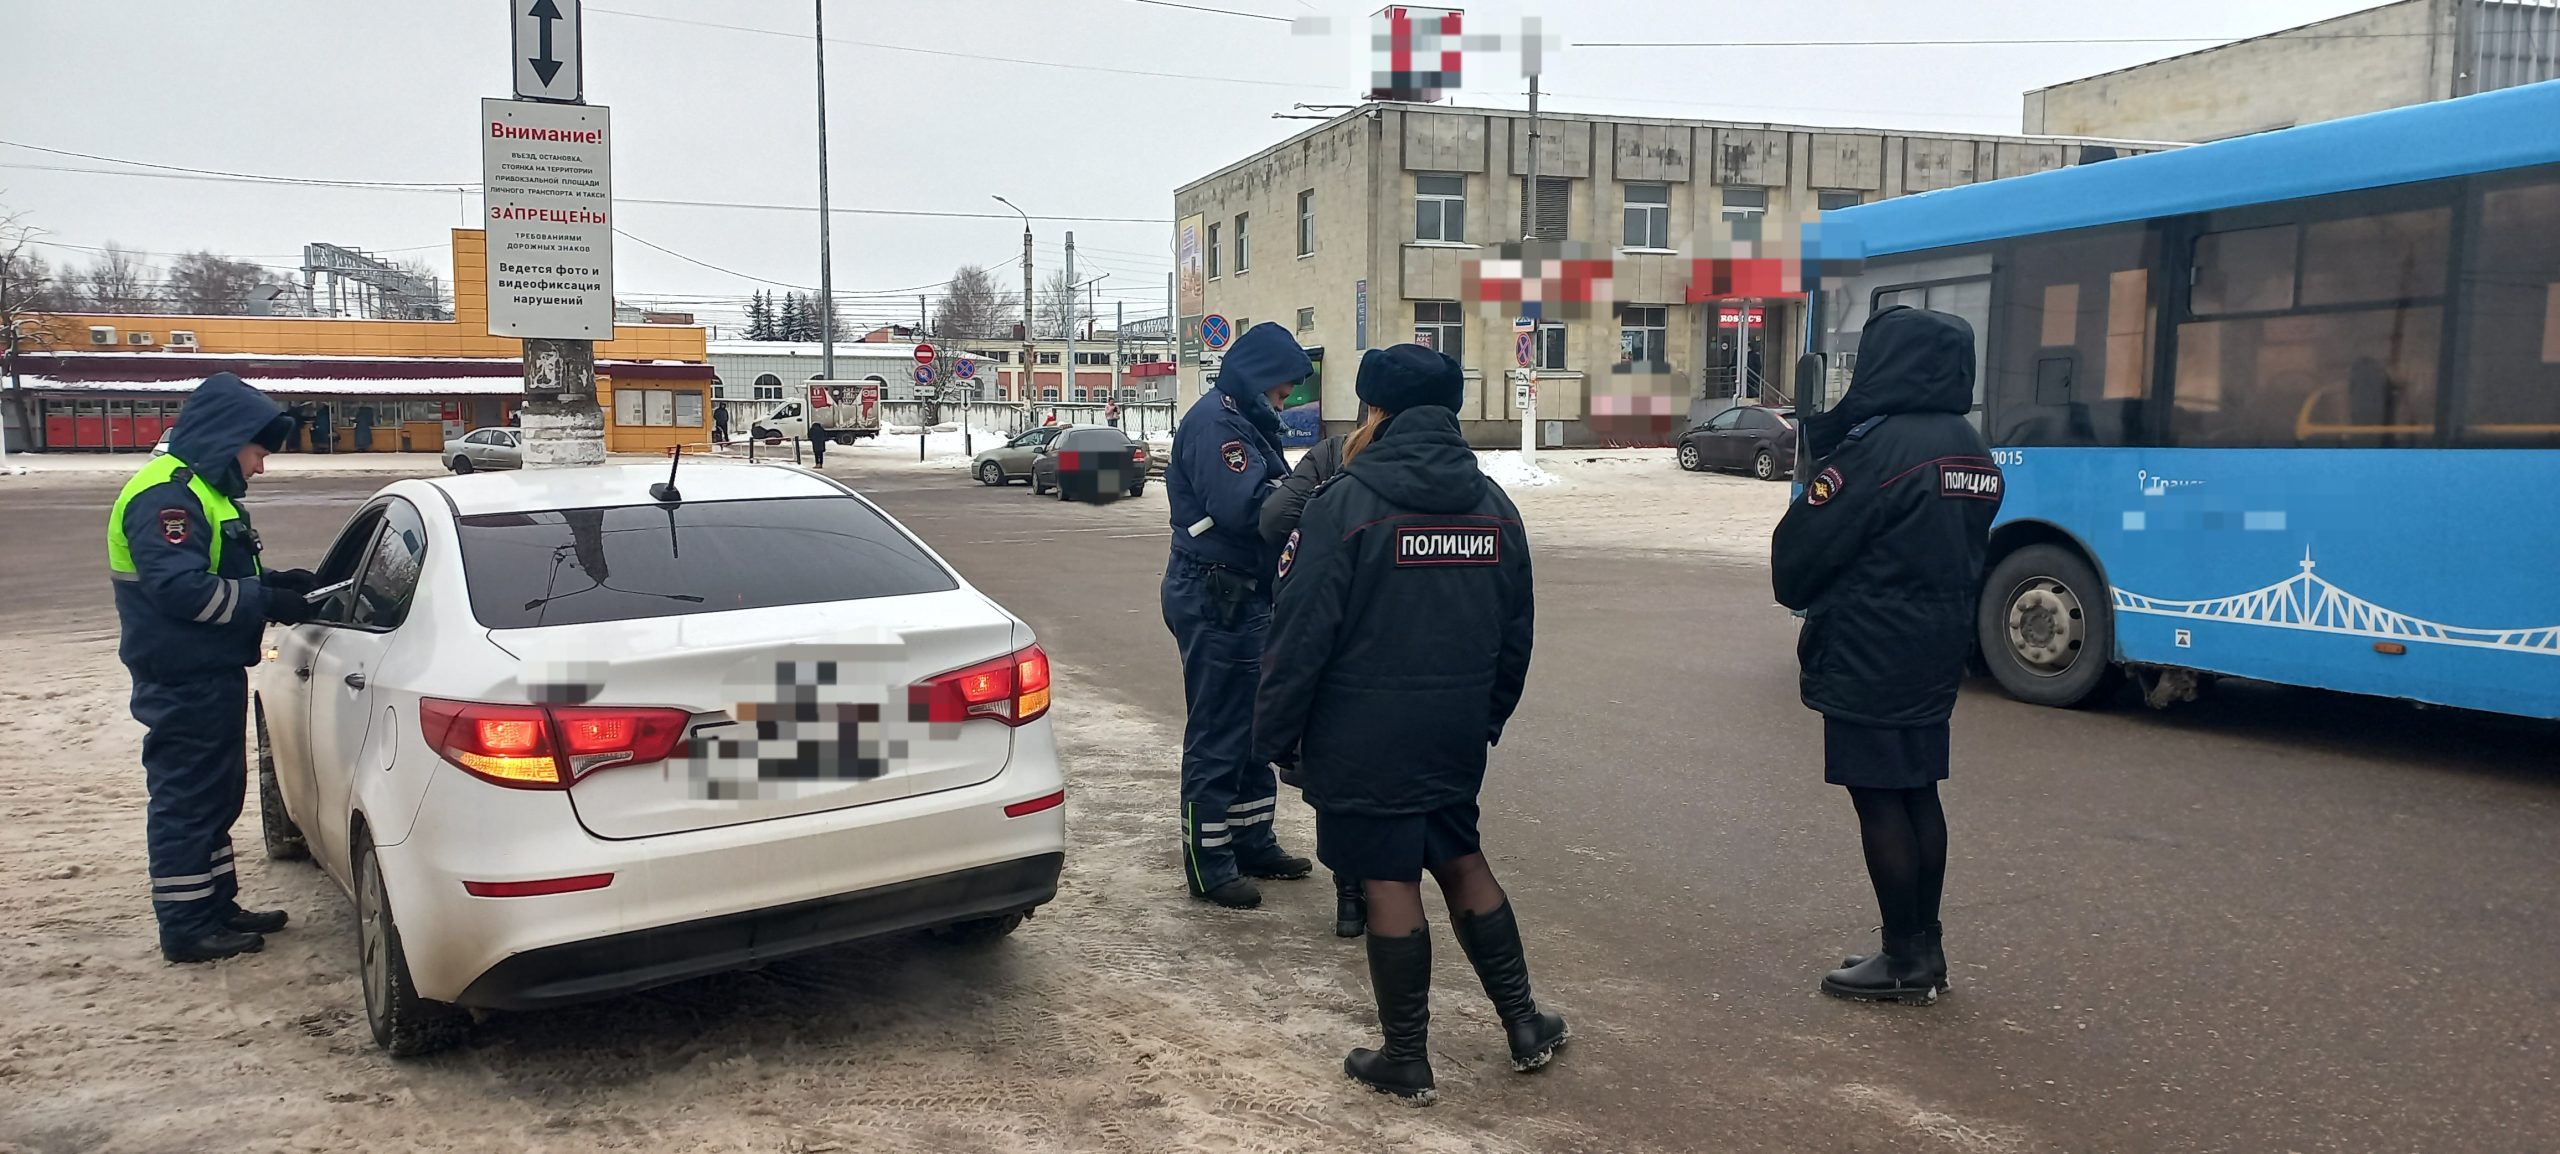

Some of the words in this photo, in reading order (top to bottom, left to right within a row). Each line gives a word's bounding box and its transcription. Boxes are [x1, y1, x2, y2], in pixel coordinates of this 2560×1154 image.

[491, 122, 602, 145] Внимание!
[511, 152, 538, 161] ВЪЕЗД,
[539, 153, 583, 163] ОСТАНОВКА,
[501, 163, 534, 171] СТОЯНКА
[547, 166, 593, 175] ТЕРРИТОРИИ
[495, 175, 559, 184] ПРИВОКЗАЛЬНОЙ
[562, 179, 600, 187] ПЛОЩАДИ
[490, 186, 525, 194] ЛИЧНОГО
[528, 188, 573, 197] ТРАНСПОРТА
[491, 206, 606, 224] ЗАПРЕЩЕНЫ
[515, 232, 582, 242] ТРЕБОВАНИЯМИ
[506, 242, 555, 251] ДОРОЖНЫХ
[499, 262, 552, 274] Ведется
[556, 264, 589, 276] фото
[592, 268, 599, 276] и
[498, 278, 601, 292] видеофиксация
[513, 295, 583, 306] нарушений
[1296, 429, 1312, 437] Russ
[1401, 534, 1495, 559] ПОЛИЦИЯ
